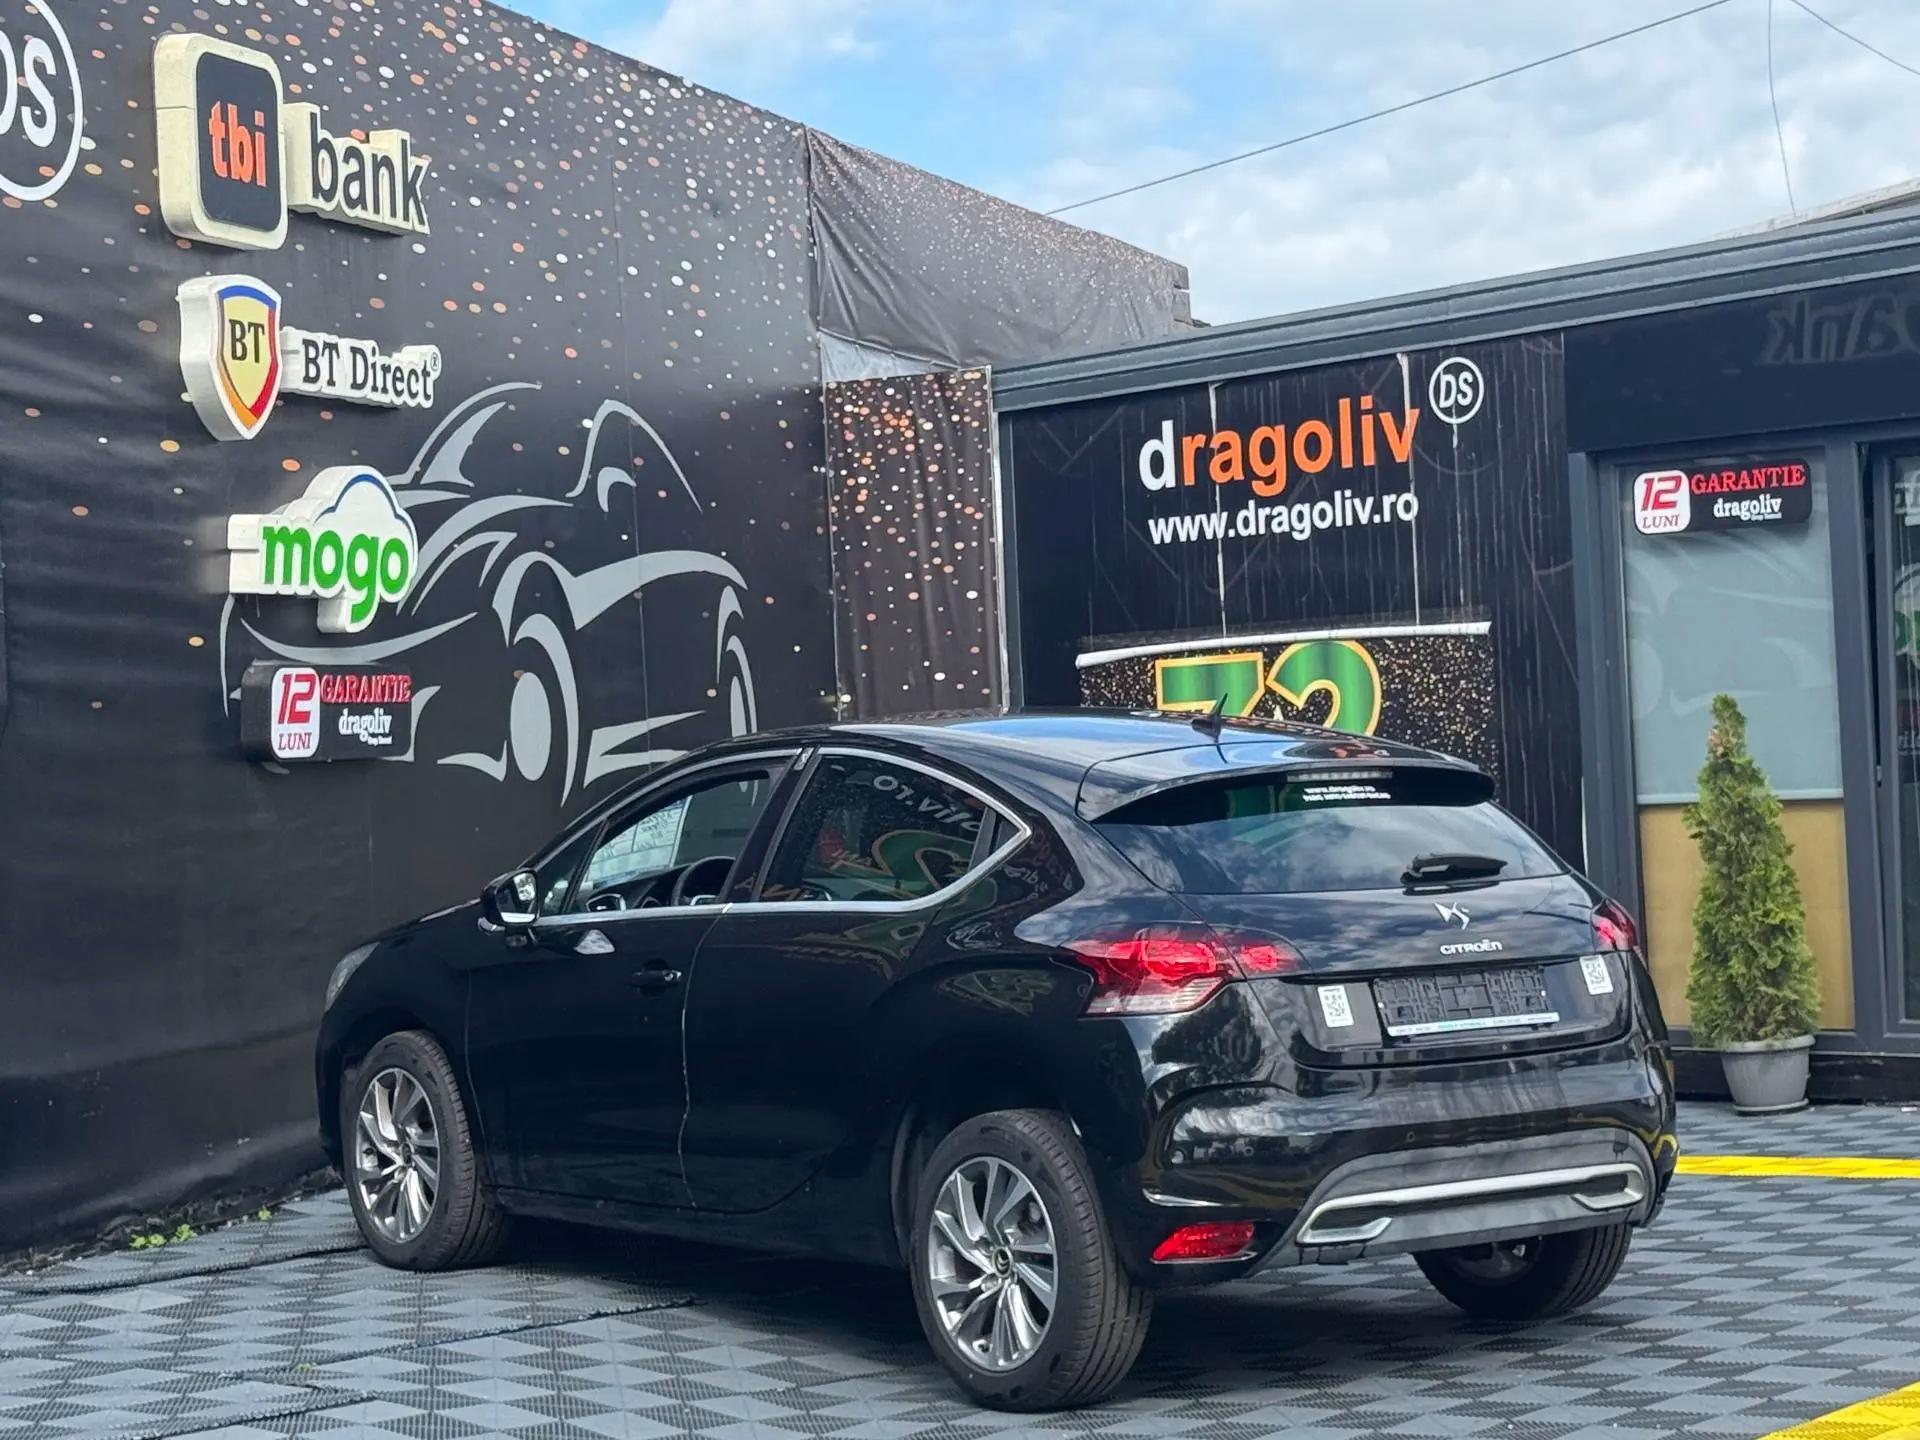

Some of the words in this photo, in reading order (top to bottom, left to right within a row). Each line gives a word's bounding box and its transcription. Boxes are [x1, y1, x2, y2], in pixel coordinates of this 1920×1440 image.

[208, 101, 267, 187] tbi
[310, 112, 427, 226] bank
[229, 319, 265, 363] BT
[302, 338, 340, 387] BT
[1438, 371, 1474, 408] DS
[1138, 395, 1420, 497] dragoliv
[1641, 475, 1683, 512] 12
[1691, 464, 1807, 495] GARANTIE
[1148, 491, 1420, 545] www.dragoliv.ro
[1642, 514, 1680, 529] LUNI
[1713, 493, 1783, 521] dragoliv
[263, 526, 409, 625] mogo
[278, 673, 317, 725] 12
[320, 673, 412, 703] GARANTIE
[278, 732, 312, 751] LUNI
[338, 707, 393, 743] dragoliv
